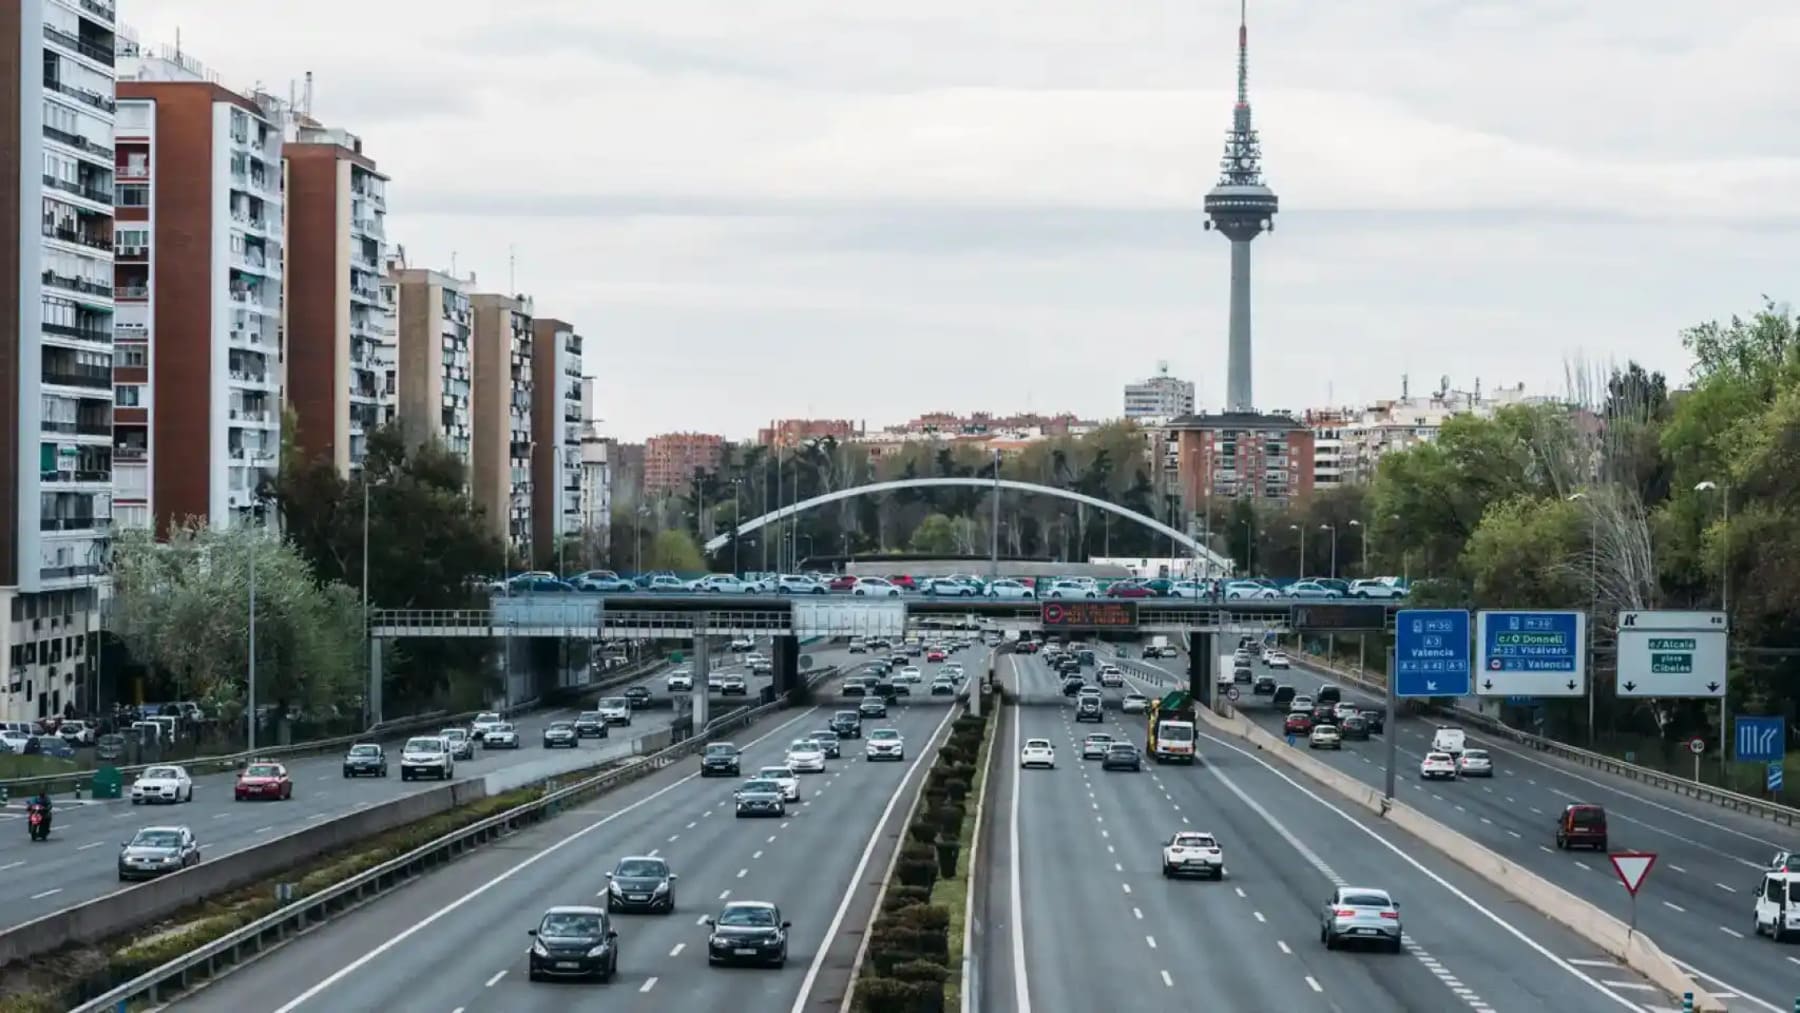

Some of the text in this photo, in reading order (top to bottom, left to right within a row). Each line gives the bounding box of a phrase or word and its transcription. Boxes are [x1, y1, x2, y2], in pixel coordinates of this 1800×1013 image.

[1523, 634, 1563, 643] Donnell
[1411, 648, 1454, 657] Valencia
[1528, 659, 1571, 669] Valencia
[1653, 664, 1691, 673] Cibeles
